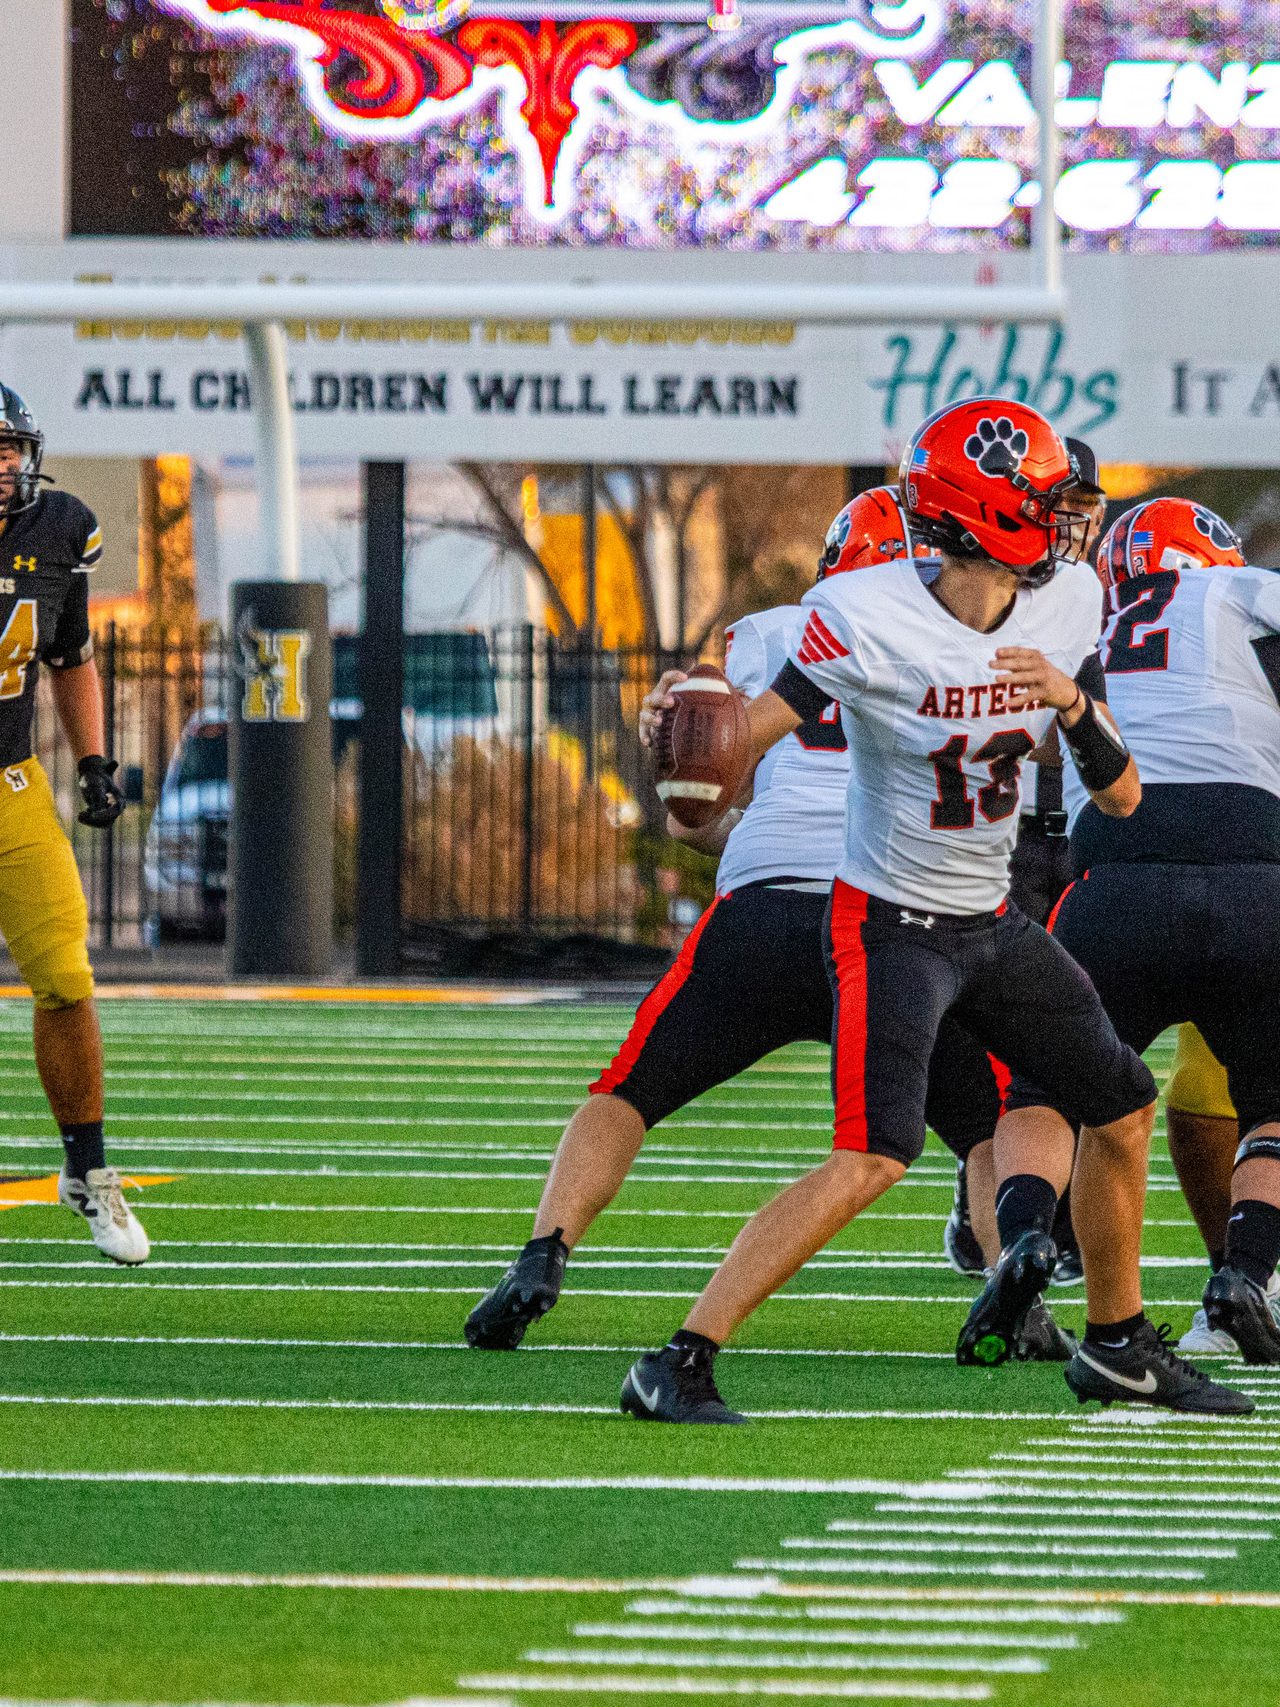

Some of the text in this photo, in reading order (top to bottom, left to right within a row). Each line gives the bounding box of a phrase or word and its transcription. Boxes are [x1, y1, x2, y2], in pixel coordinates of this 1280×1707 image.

[75, 366, 176, 412] ALL
[466, 371, 606, 415] WILL
[620, 373, 798, 417] LEARN
[868, 318, 1119, 435] Hobbs
[928, 728, 1036, 831] 13
